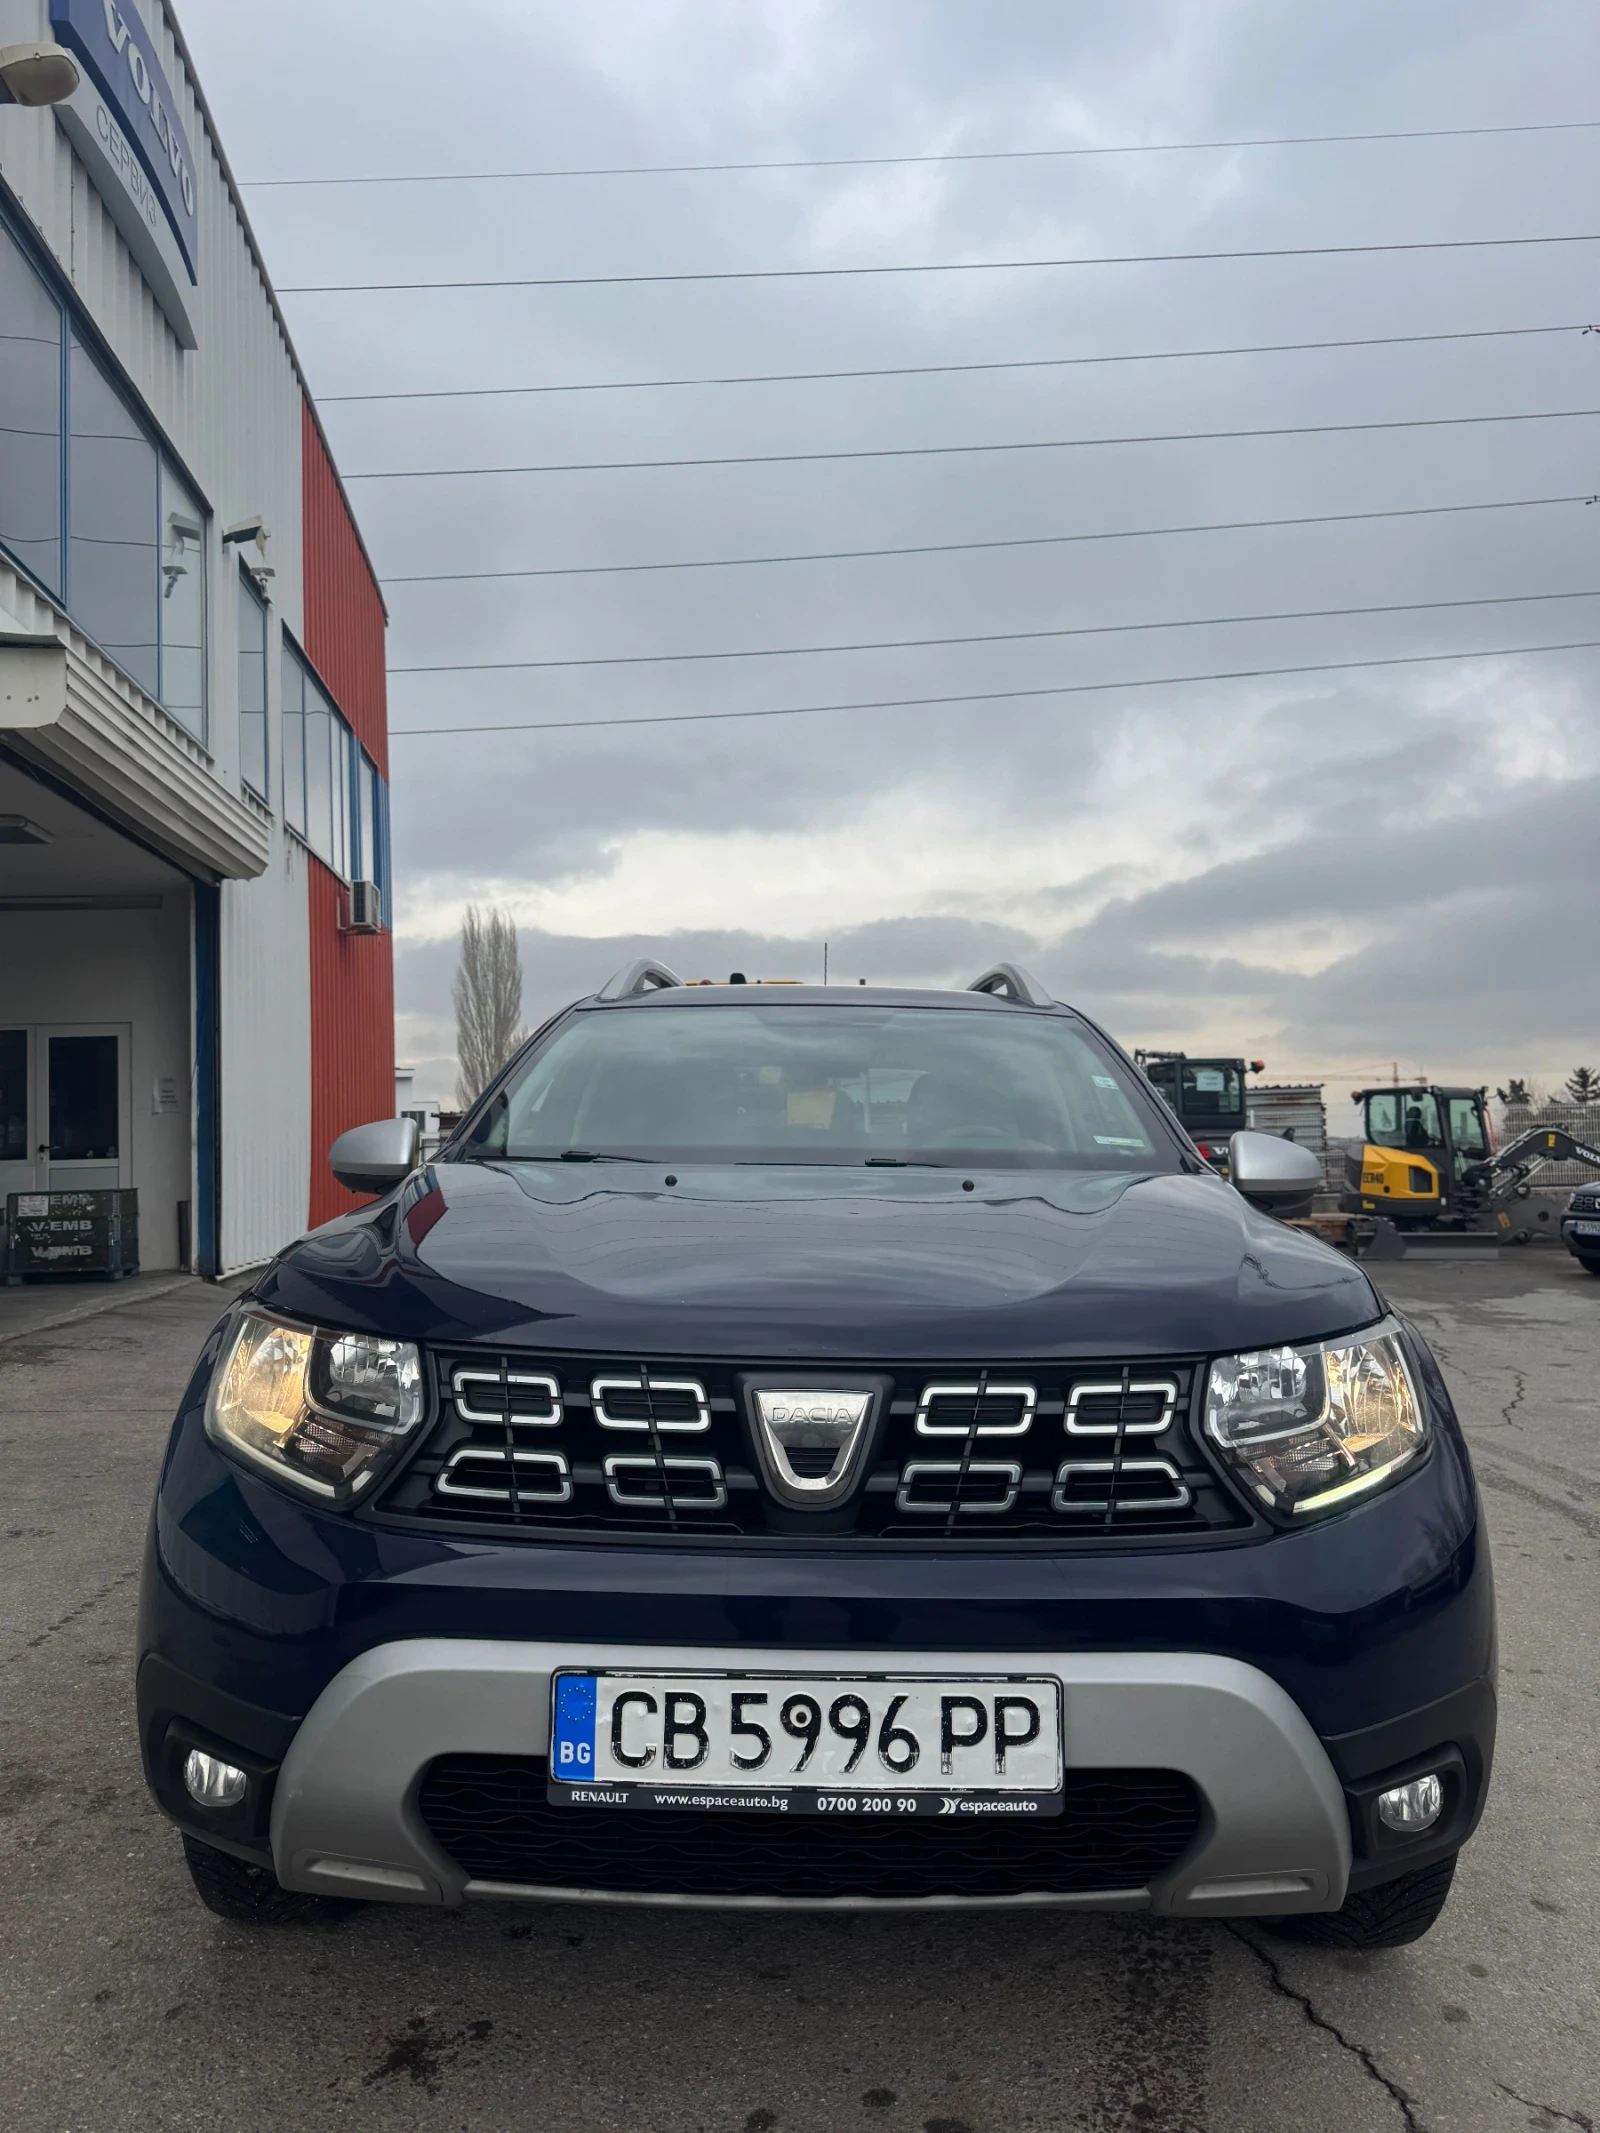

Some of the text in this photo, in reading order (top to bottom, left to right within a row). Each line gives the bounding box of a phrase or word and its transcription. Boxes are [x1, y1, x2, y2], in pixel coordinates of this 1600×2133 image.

[102, 0, 193, 217] VOLVO
[96, 104, 157, 228] СЕРВИЗ
[31, 1220, 93, 1232] V-EMB
[772, 1407, 853, 1424] DACIA
[611, 1690, 1041, 1775] CB 5996 PP
[560, 1741, 591, 1764] BG
[571, 1790, 1038, 1815] RENAULT www.espaceauto.bg 0700 200 90 espaceauto
